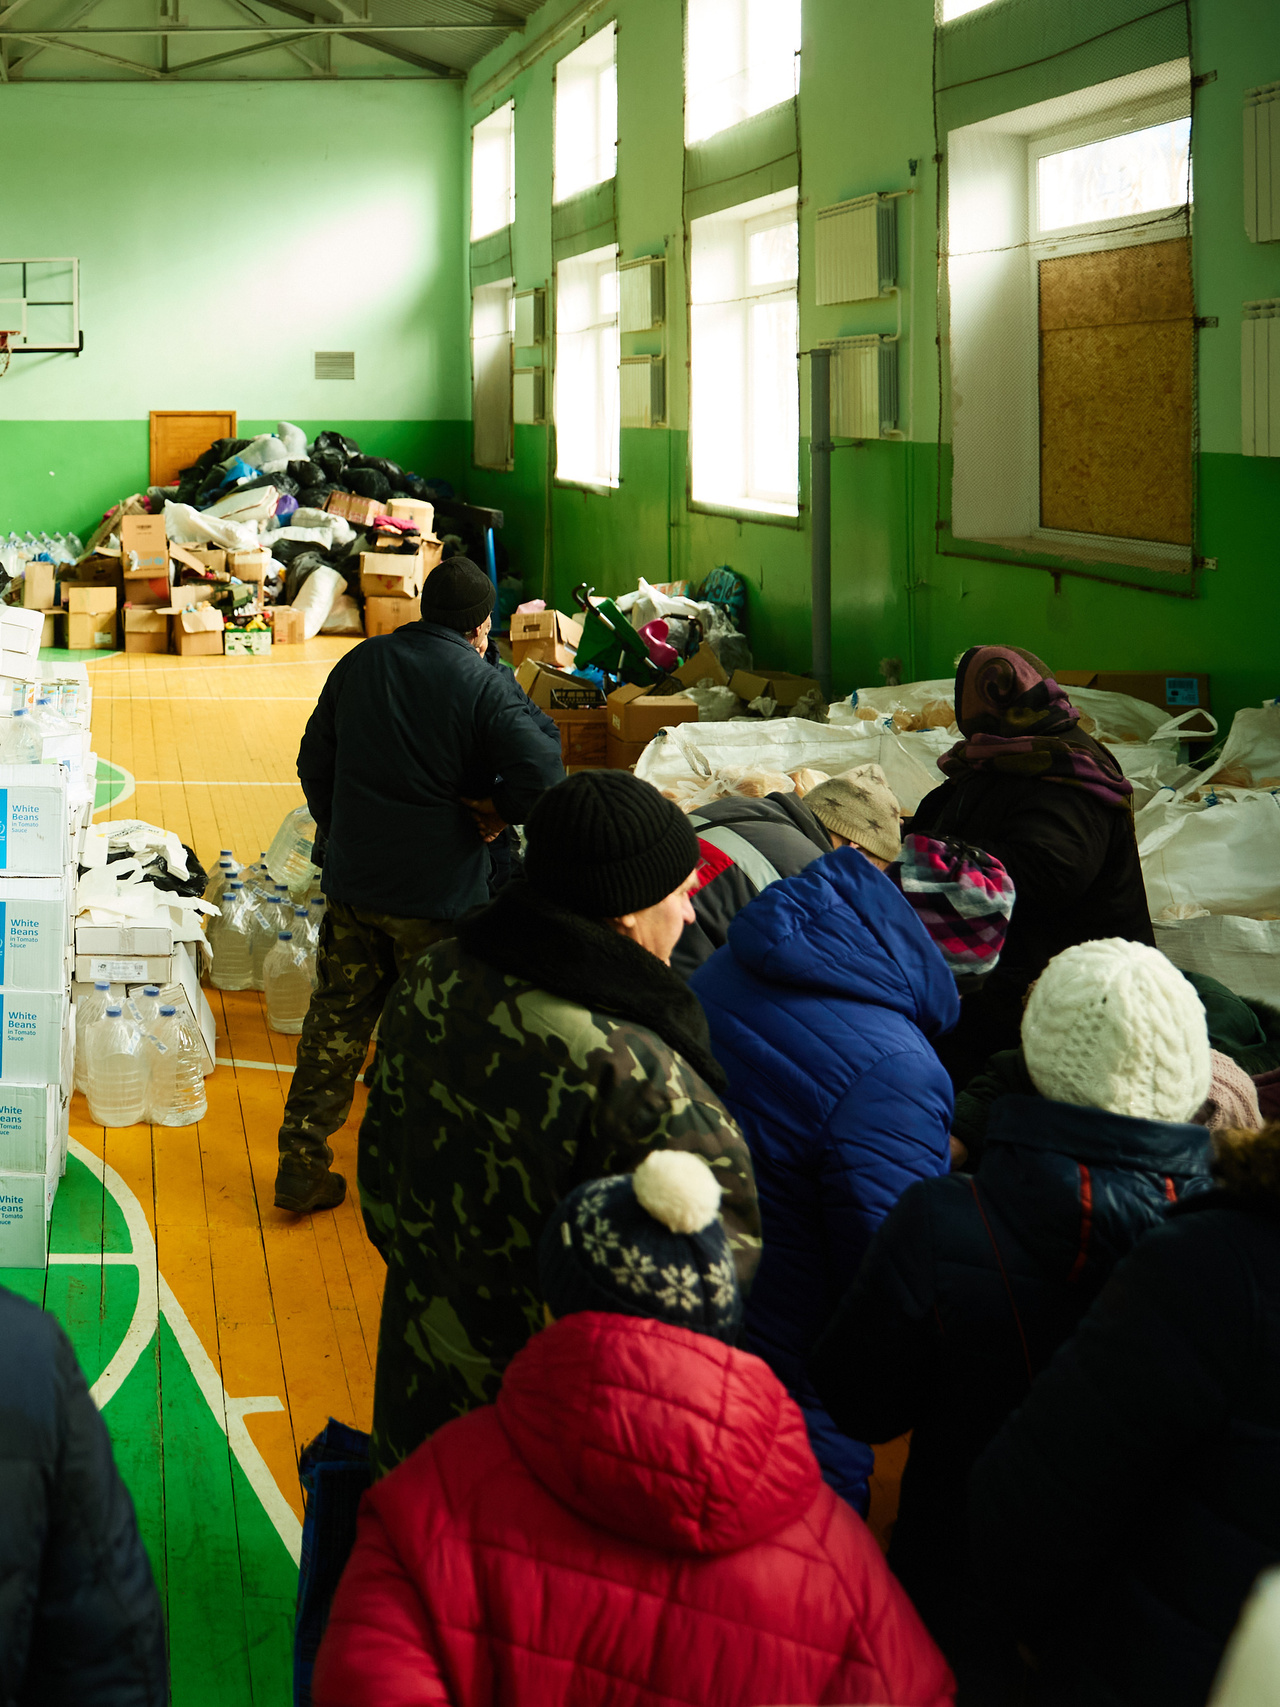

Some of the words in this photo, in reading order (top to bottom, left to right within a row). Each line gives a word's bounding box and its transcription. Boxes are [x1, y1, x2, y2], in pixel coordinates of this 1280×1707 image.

[12, 805, 40, 813] White
[12, 813, 39, 821] Beans
[11, 919, 39, 928] White
[10, 928, 39, 936] Beans
[8, 1012, 37, 1020] White
[8, 1020, 36, 1029] Beans
